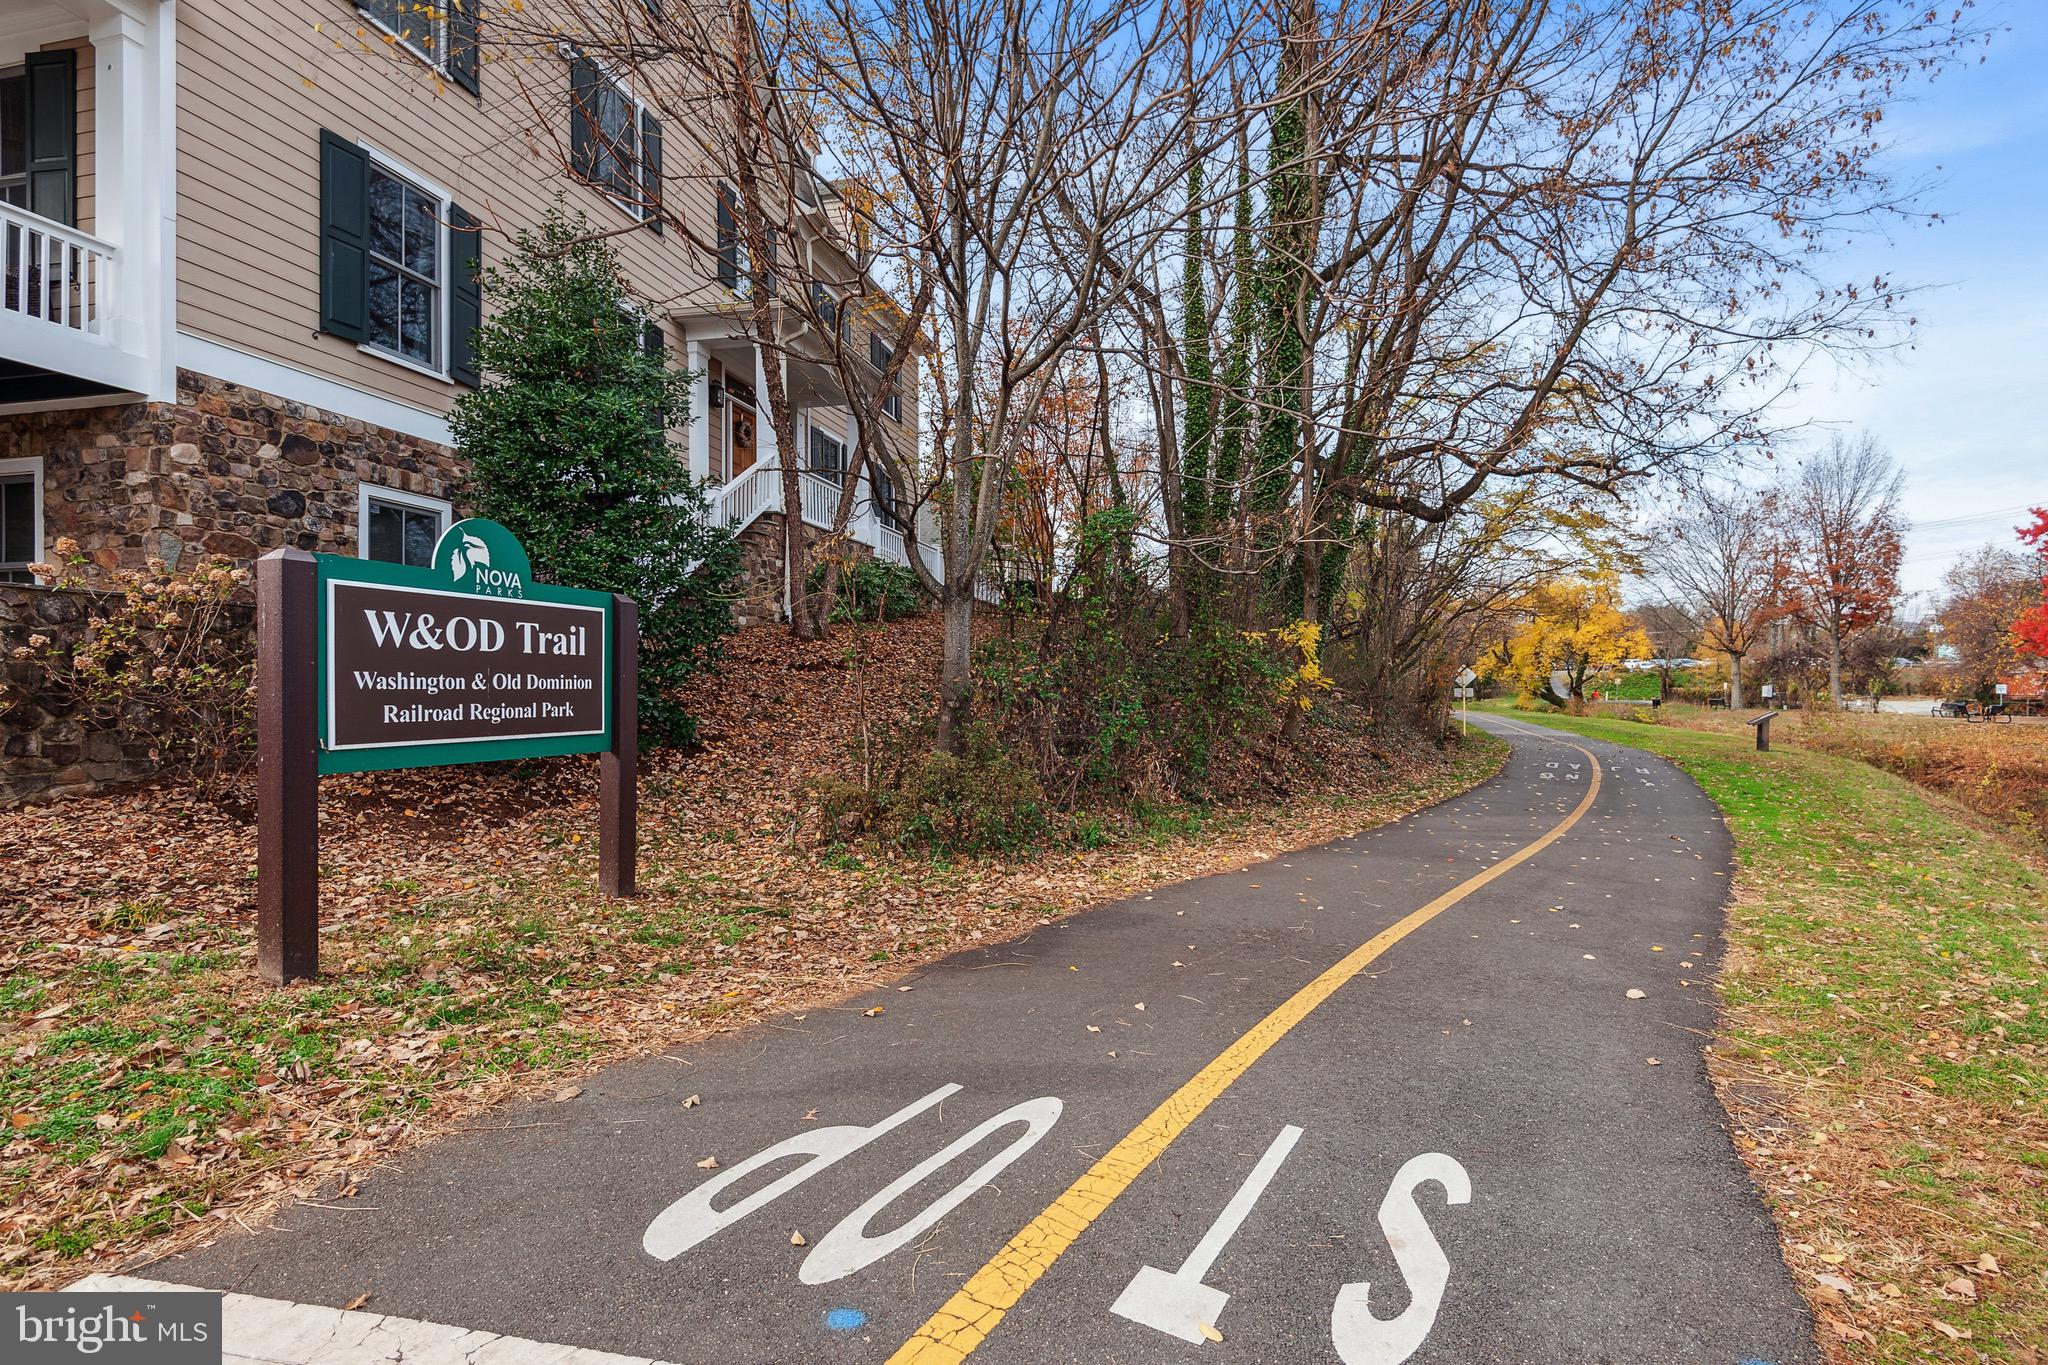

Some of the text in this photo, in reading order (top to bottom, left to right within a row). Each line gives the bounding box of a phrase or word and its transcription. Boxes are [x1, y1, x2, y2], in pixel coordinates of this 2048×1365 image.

[475, 568, 522, 589] NOVA
[475, 585, 524, 599] PARKS
[364, 609, 587, 657] W&OD Trail
[353, 671, 593, 696] Washington & Old Dominion
[383, 701, 575, 724] Railroad Regional Park
